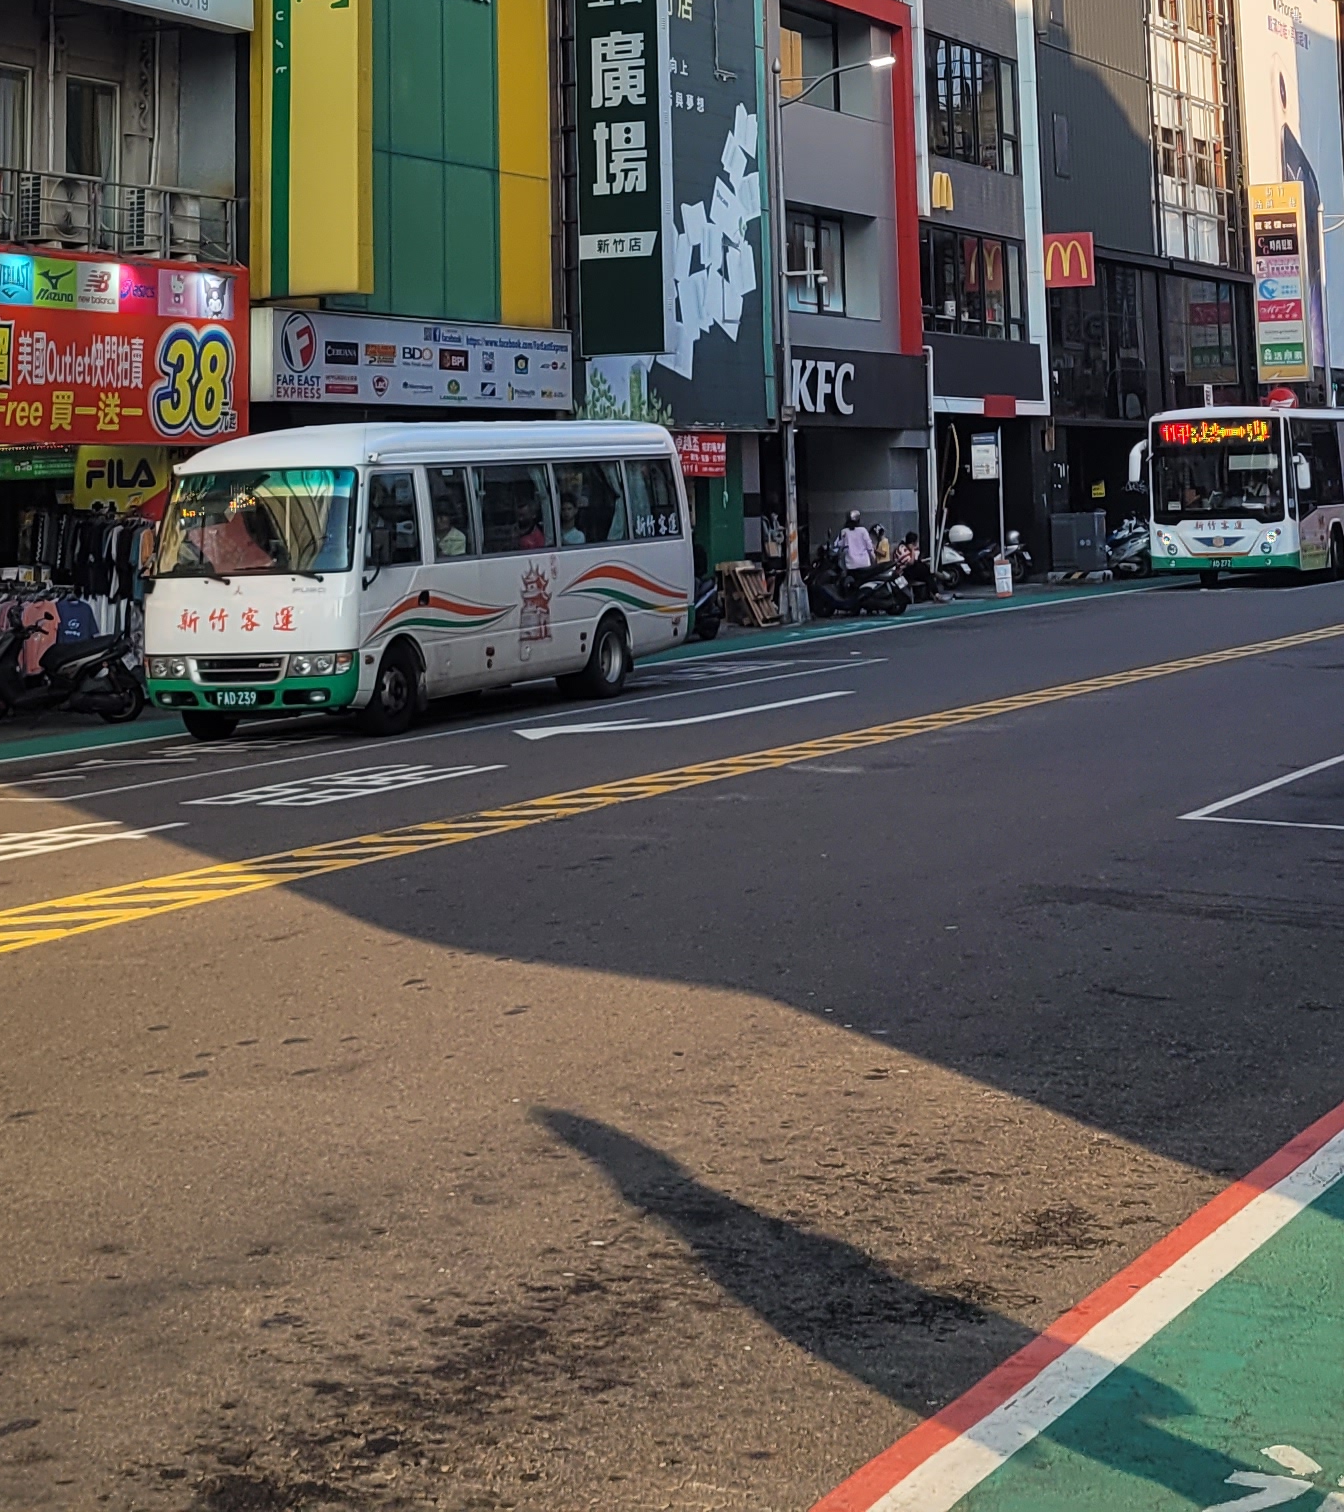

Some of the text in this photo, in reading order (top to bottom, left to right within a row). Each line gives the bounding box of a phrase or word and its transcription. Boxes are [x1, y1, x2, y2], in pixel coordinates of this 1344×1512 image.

[590, 31, 648, 197] 廣場
[596, 235, 644, 255] 新竹店
[77, 296, 117, 306] new balance
[402, 346, 433, 361] BDO
[451, 355, 465, 367] BPI
[154, 325, 232, 435] 38
[276, 374, 295, 387] FAR
[297, 375, 322, 387] EAST
[792, 360, 856, 416] KFC
[276, 386, 322, 400] EXPRESS
[50, 391, 144, 432] 買一送一
[85, 457, 157, 489] FILA
[176, 604, 299, 634] 新竹客運
[216, 690, 257, 706] FAD-239
